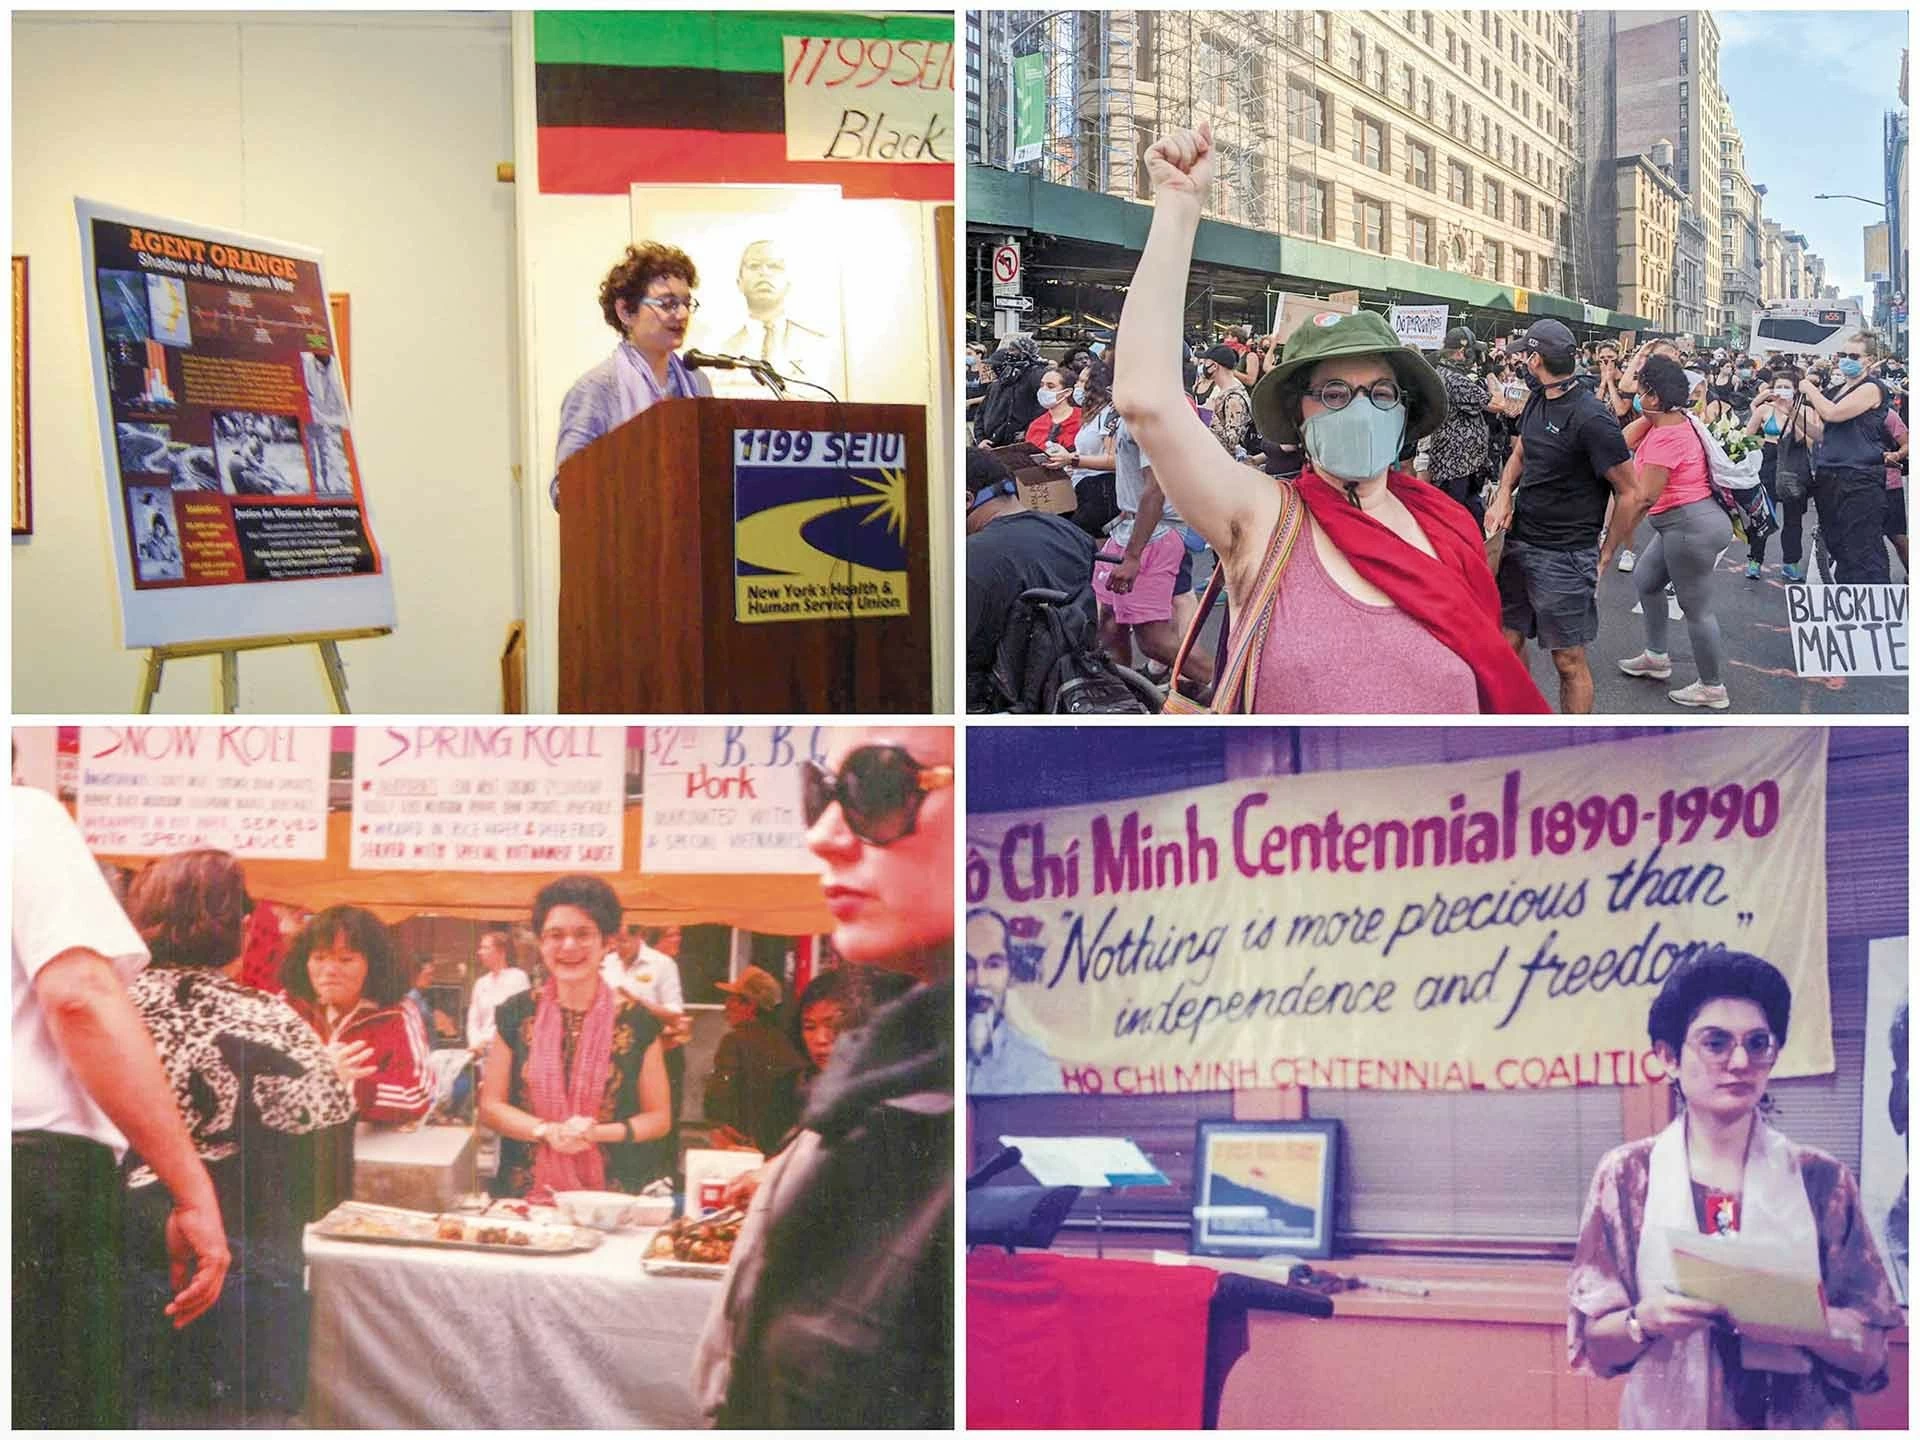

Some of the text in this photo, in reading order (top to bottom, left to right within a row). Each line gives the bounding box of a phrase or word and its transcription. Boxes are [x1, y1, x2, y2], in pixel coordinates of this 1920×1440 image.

[823, 109, 953, 161] Black
[129, 228, 298, 280] AGENT ORANGE
[137, 252, 188, 275] Shadow
[203, 265, 224, 281] the
[739, 430, 901, 463] 1199 SEIU
[747, 581, 893, 600] New York's Health &
[748, 597, 900, 615] Human Service Union
[1798, 622, 1909, 673] MATTE
[377, 726, 514, 767] SPRING
[686, 763, 758, 800] Pork
[1001, 821, 1080, 903] Chí
[1091, 803, 1219, 897] Minh
[1232, 769, 1522, 879] Centennial
[1529, 778, 1781, 857] 1890-1990
[1242, 912, 1274, 952] is
[1284, 902, 1382, 948] more
[1382, 878, 1590, 958] precious
[1606, 845, 1731, 914] than
[1114, 966, 1395, 1045] independence
[1414, 946, 1509, 1012] and
[1061, 1066, 1104, 1095] HO
[1113, 1063, 1166, 1093] CHI
[1175, 1058, 1259, 1092] MINH
[1271, 1055, 1487, 1091] CENTENNIAL
